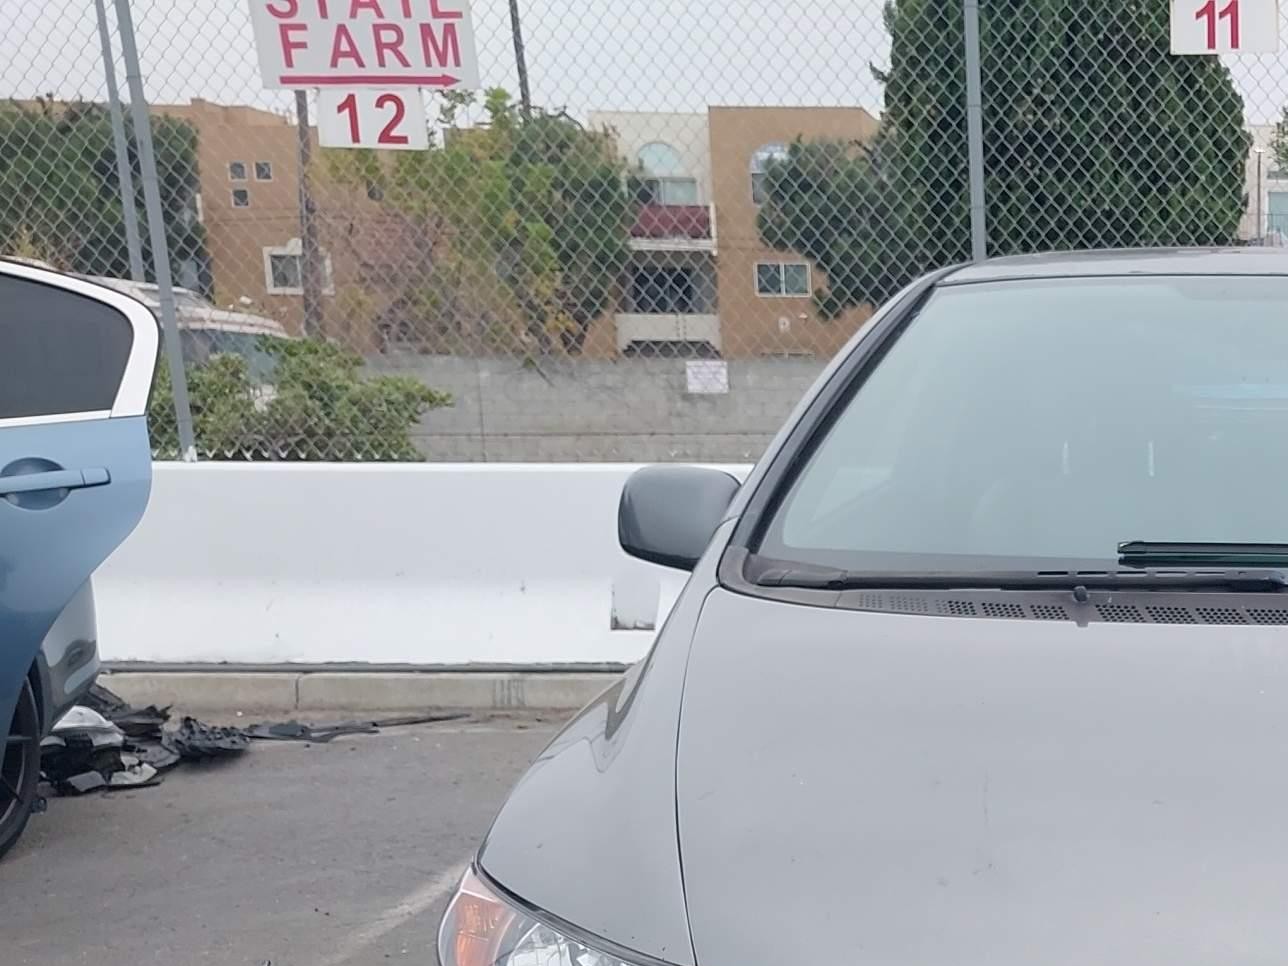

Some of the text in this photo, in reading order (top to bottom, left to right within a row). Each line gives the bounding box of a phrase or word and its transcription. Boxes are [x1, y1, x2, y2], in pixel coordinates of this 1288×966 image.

[278, 23, 462, 68] FARM
[1194, 0, 1239, 50] 11
[336, 93, 409, 144] 12
